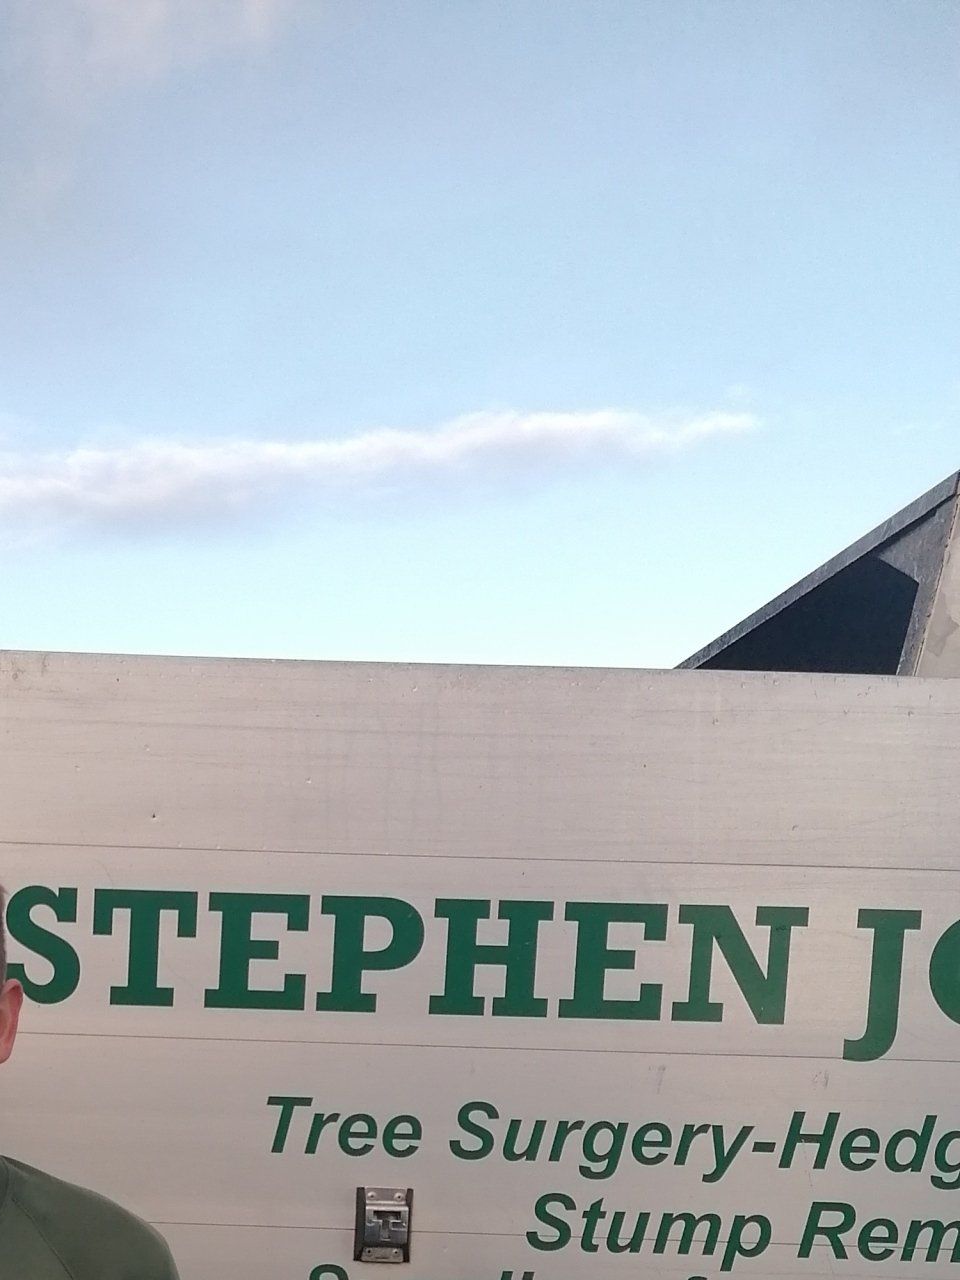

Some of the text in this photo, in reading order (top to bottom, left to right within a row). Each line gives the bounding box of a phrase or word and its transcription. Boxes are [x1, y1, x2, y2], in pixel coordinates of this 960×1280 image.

[6, 886, 960, 1062] STEPHEN J
[267, 1096, 422, 1157] Tree
[526, 1193, 960, 1271] Stump Rem
